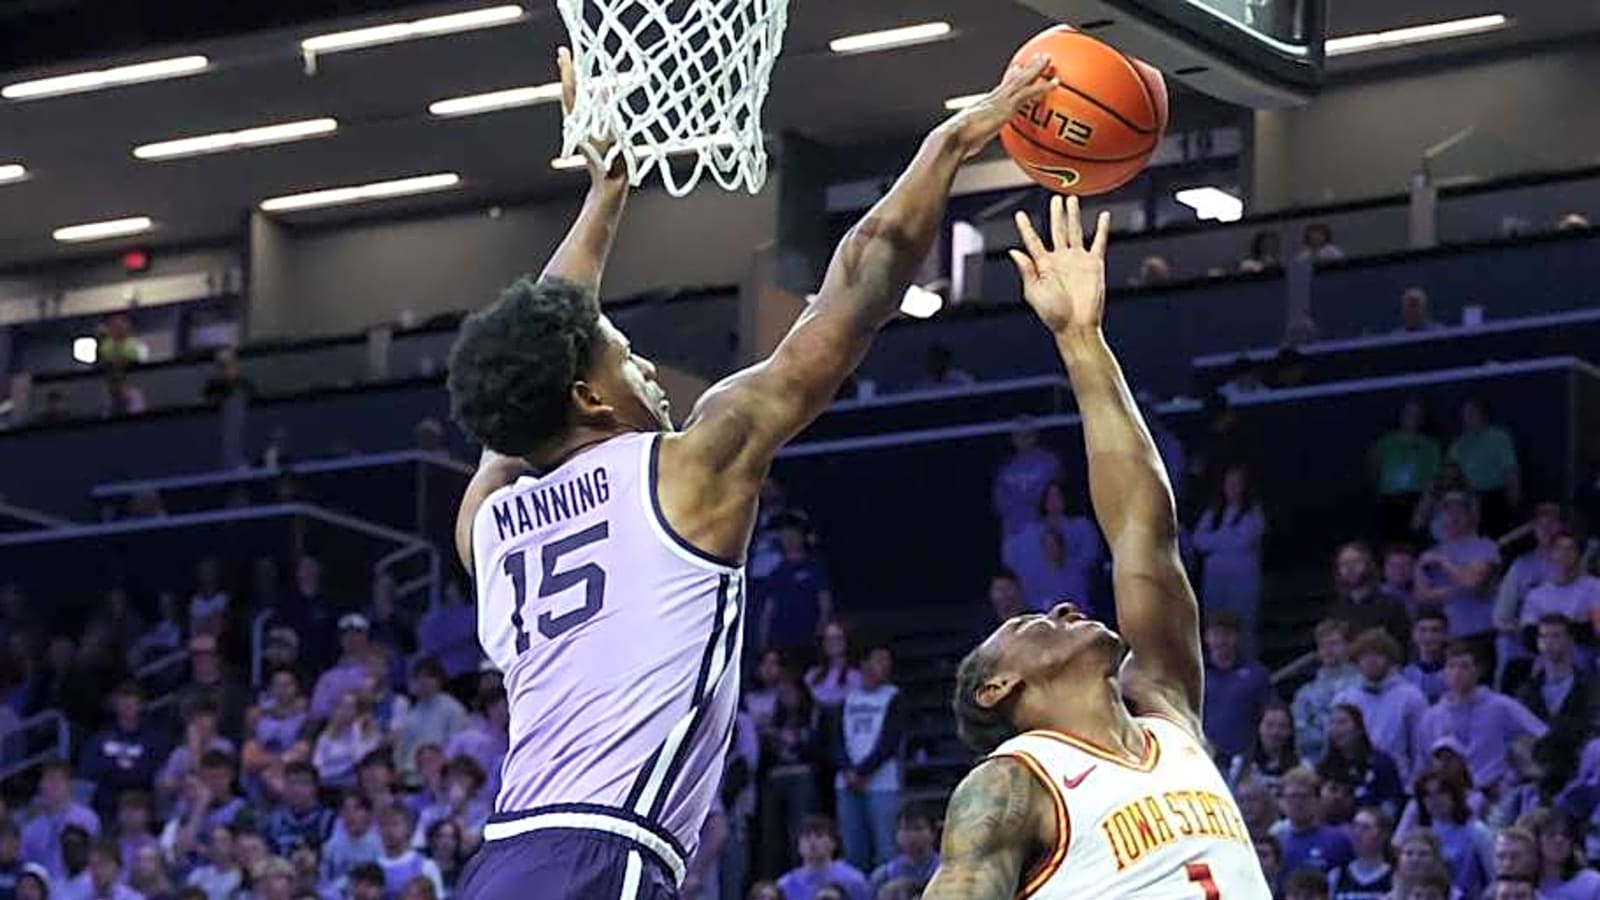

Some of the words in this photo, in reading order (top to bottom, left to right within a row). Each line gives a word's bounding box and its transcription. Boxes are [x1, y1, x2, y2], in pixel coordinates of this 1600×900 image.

[492, 466, 611, 541] MANNING
[503, 519, 609, 655] 15
[1101, 796, 1175, 871] IOWA
